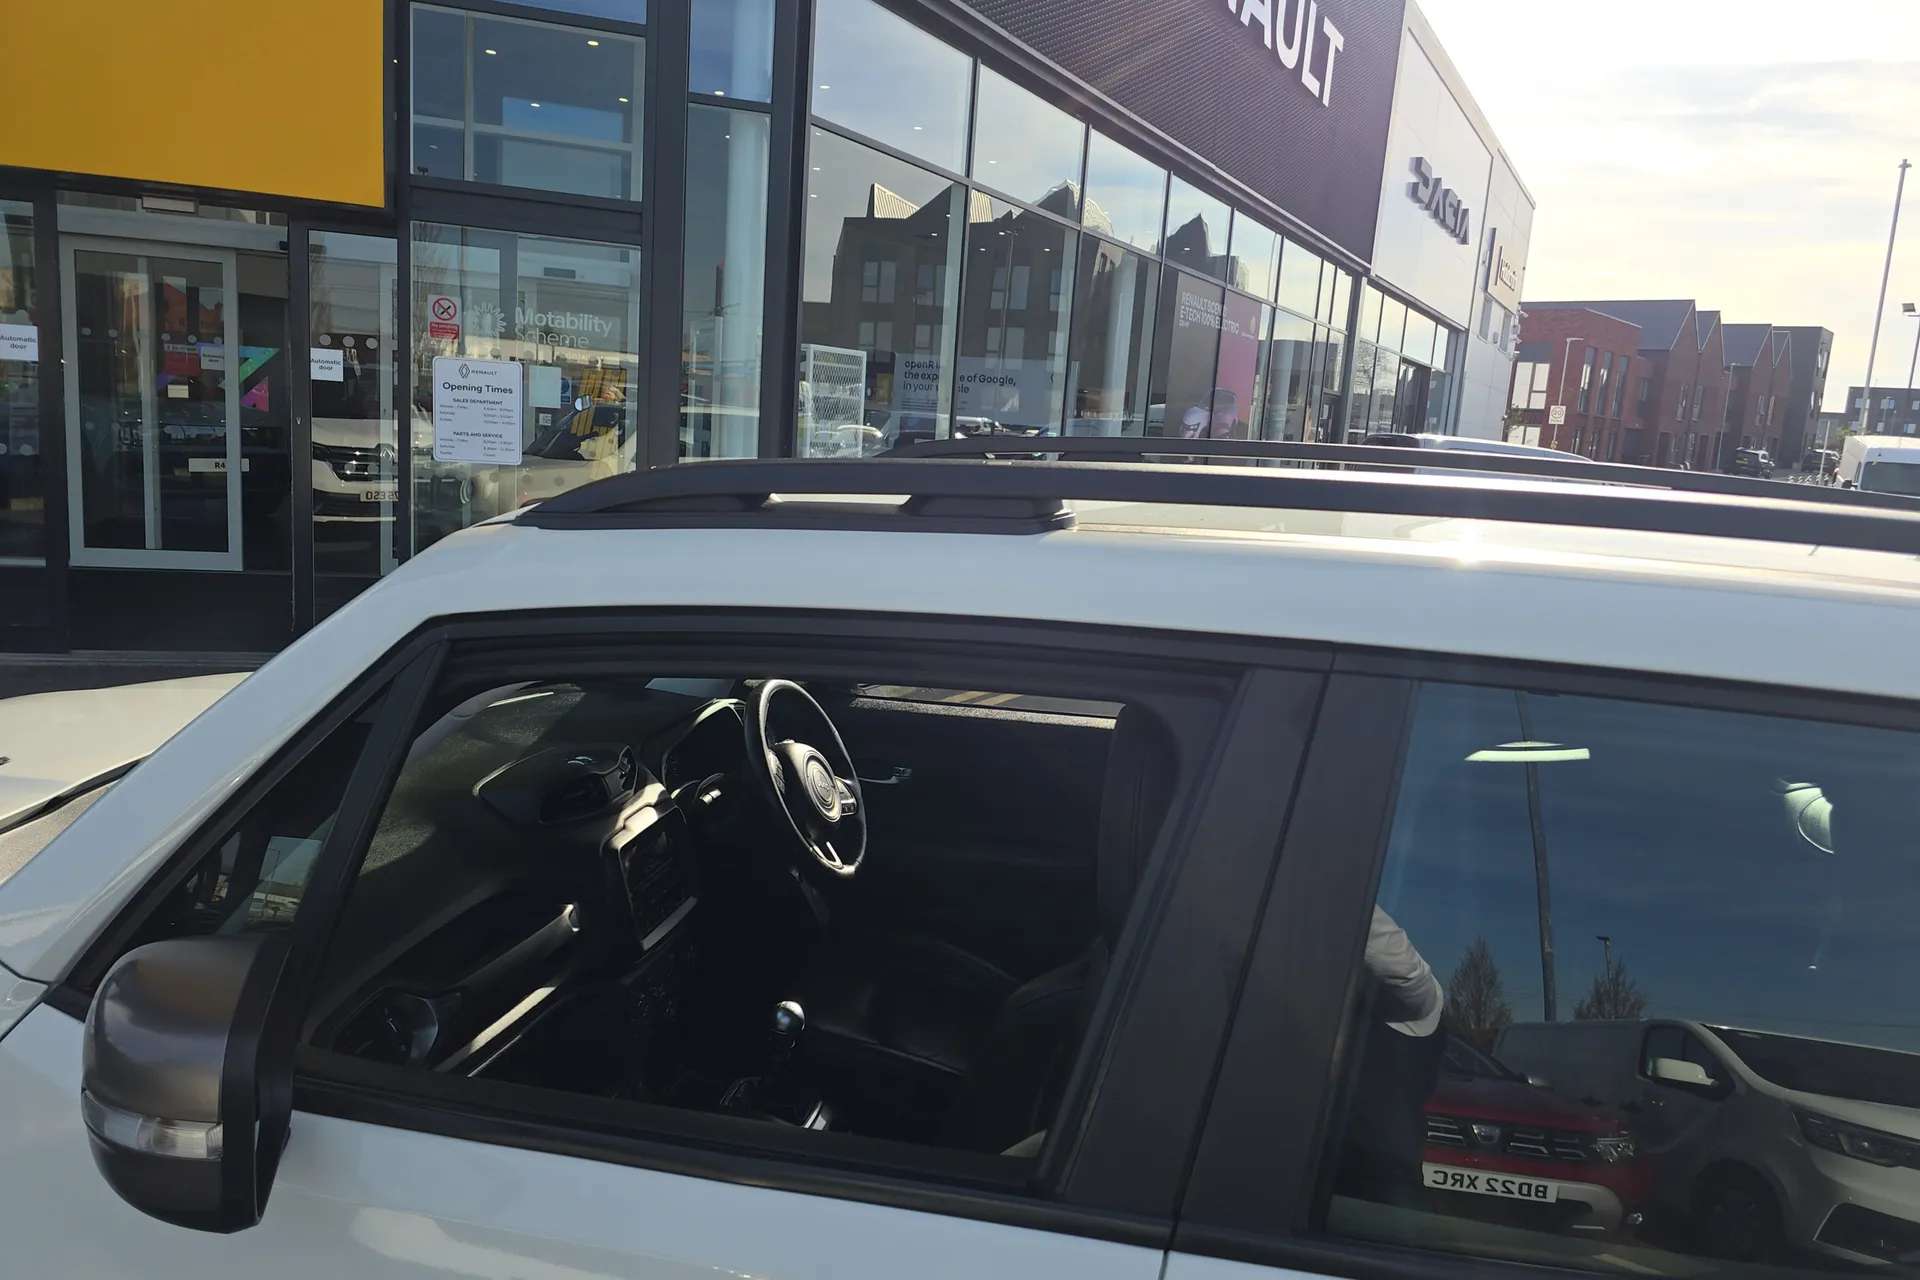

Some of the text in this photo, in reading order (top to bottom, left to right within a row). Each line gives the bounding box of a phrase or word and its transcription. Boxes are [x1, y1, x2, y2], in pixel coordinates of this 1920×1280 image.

[515, 306, 612, 337] Motability
[515, 326, 589, 348] Scheme
[904, 371, 919, 380] the
[967, 373, 977, 382] of
[979, 375, 1016, 386] Google,
[442, 381, 513, 394] Opening Times
[903, 382, 912, 390] in
[913, 383, 934, 393] your
[469, 398, 504, 406] DEPARTMENT
